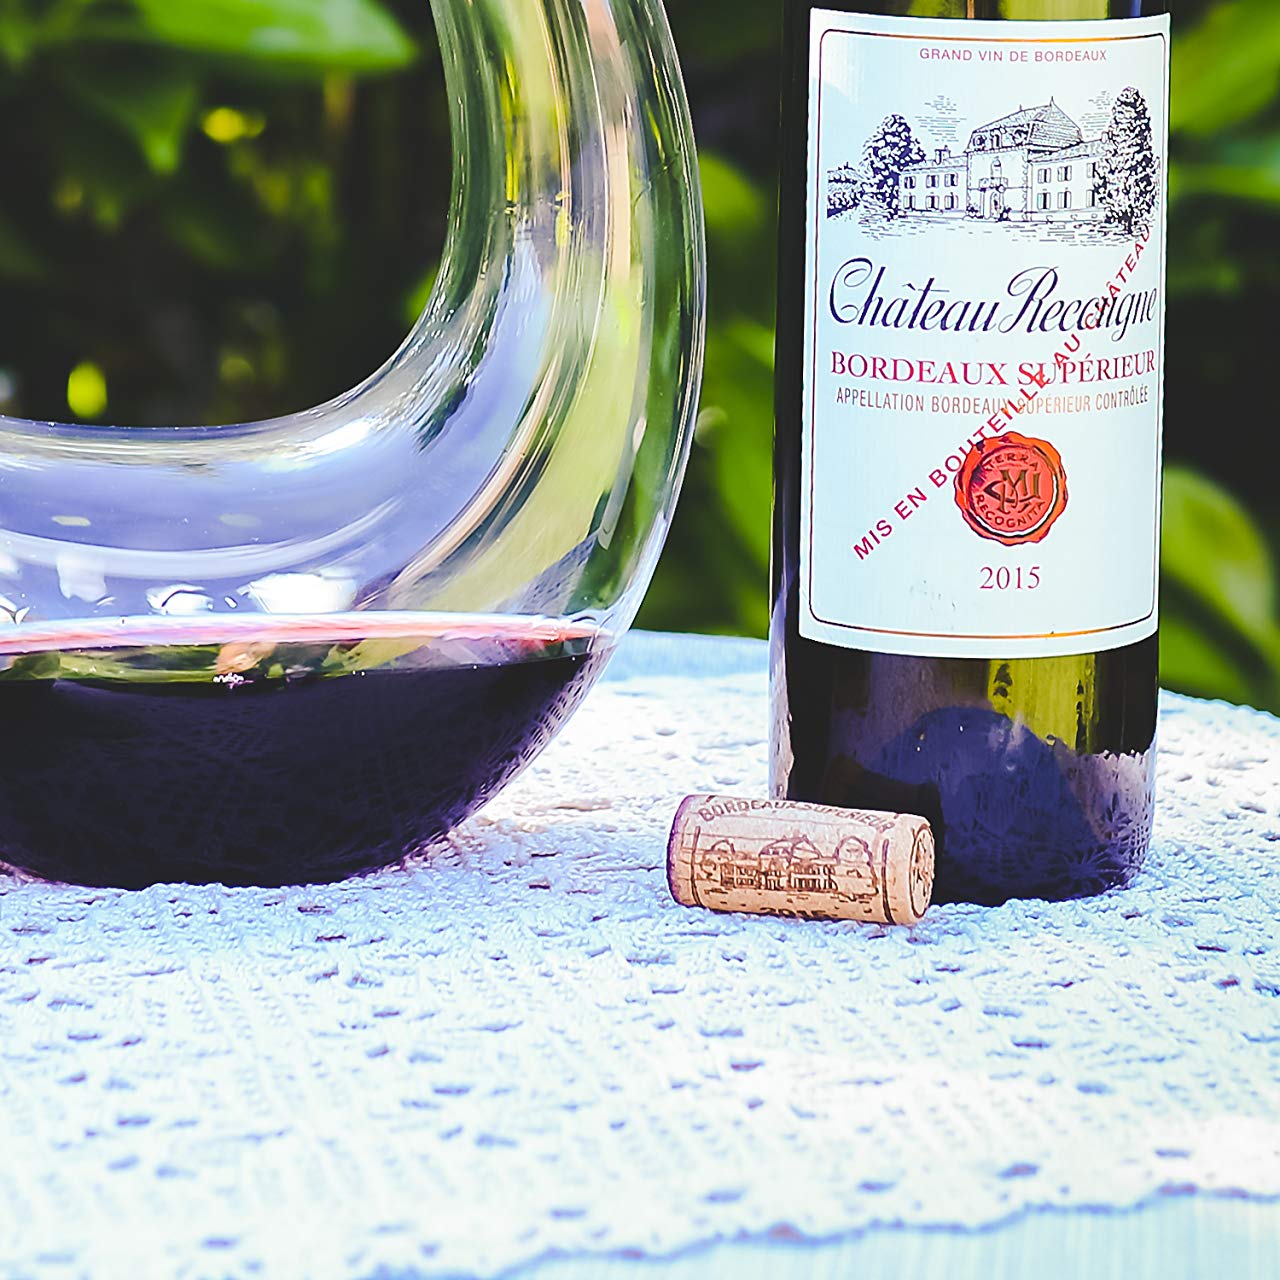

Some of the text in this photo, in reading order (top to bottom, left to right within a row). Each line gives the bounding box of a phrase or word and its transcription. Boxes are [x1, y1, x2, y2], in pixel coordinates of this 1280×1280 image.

[919, 47, 1107, 62] GRAND VIN DE BORDEAUX
[829, 257, 1001, 331] Château
[831, 350, 1155, 386] BORDEAUX SUPÉRIEUR
[836, 384, 1149, 415] APPELLATION BORDEAUX SUPÉRIEUR CONTRÔLÉE
[853, 519, 893, 560] MIS
[894, 487, 928, 520] EN
[928, 370, 1051, 488] BOUTEILLE
[1053, 333, 1081, 370] AU
[1085, 223, 1151, 330] CHÂTEAU
[979, 566, 1041, 591] 2015
[698, 799, 797, 821] BORDEAUX
